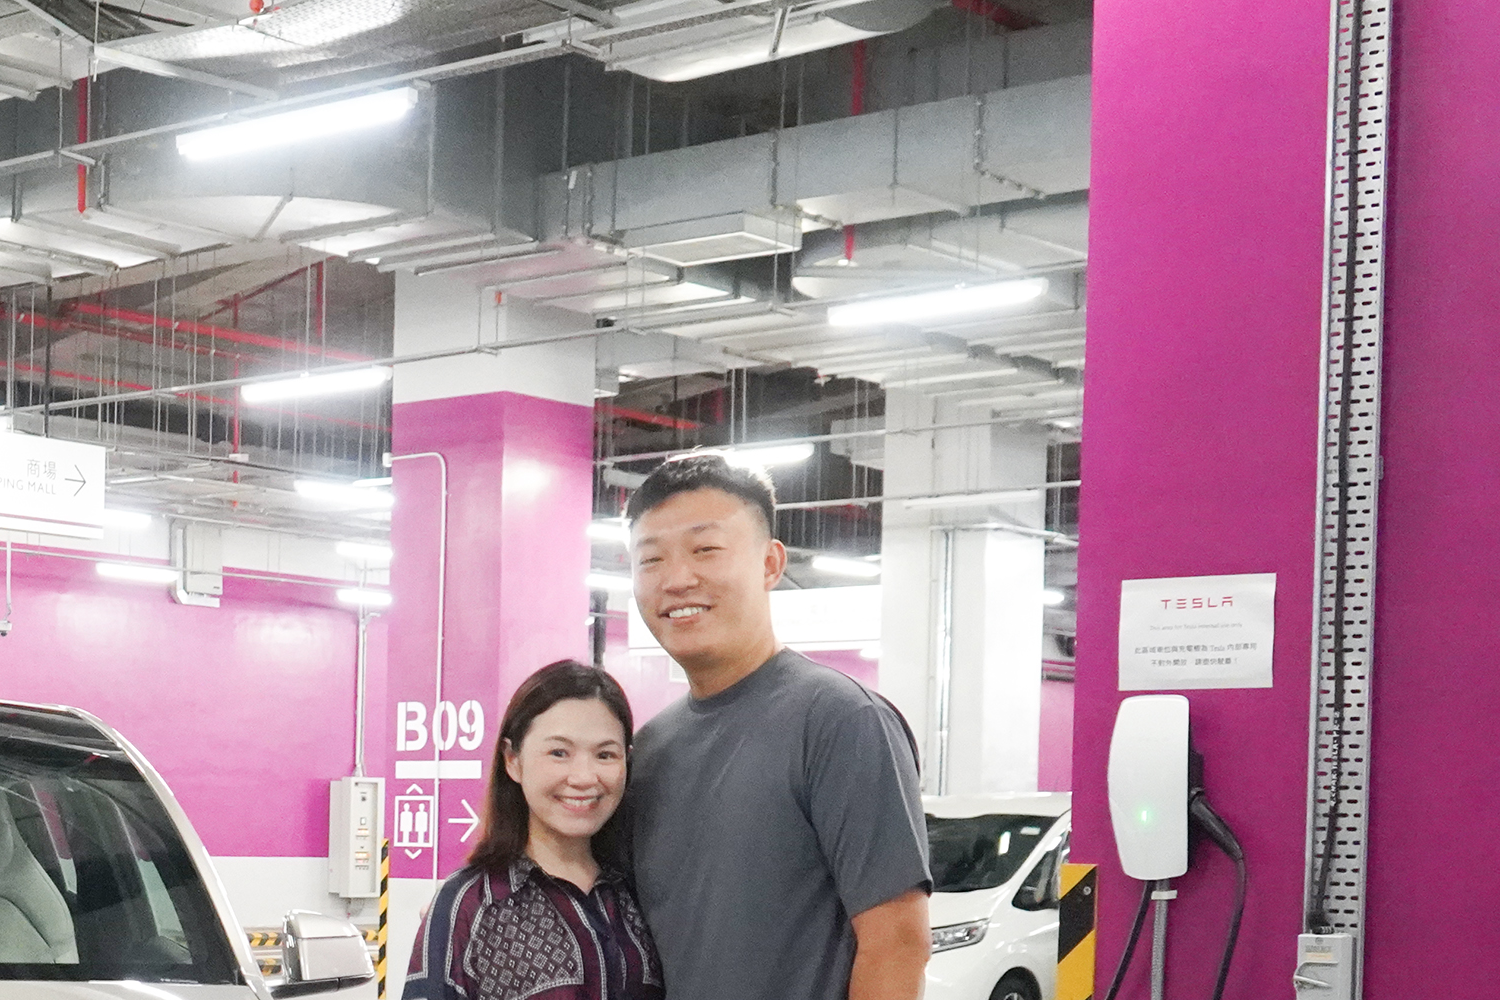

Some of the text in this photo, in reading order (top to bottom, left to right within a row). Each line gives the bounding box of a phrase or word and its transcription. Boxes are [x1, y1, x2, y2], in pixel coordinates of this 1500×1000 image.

[27, 459, 57, 480] 商場
[28, 481, 56, 495] MALL
[1160, 596, 1233, 610] TESLA
[396, 699, 485, 752] B09
